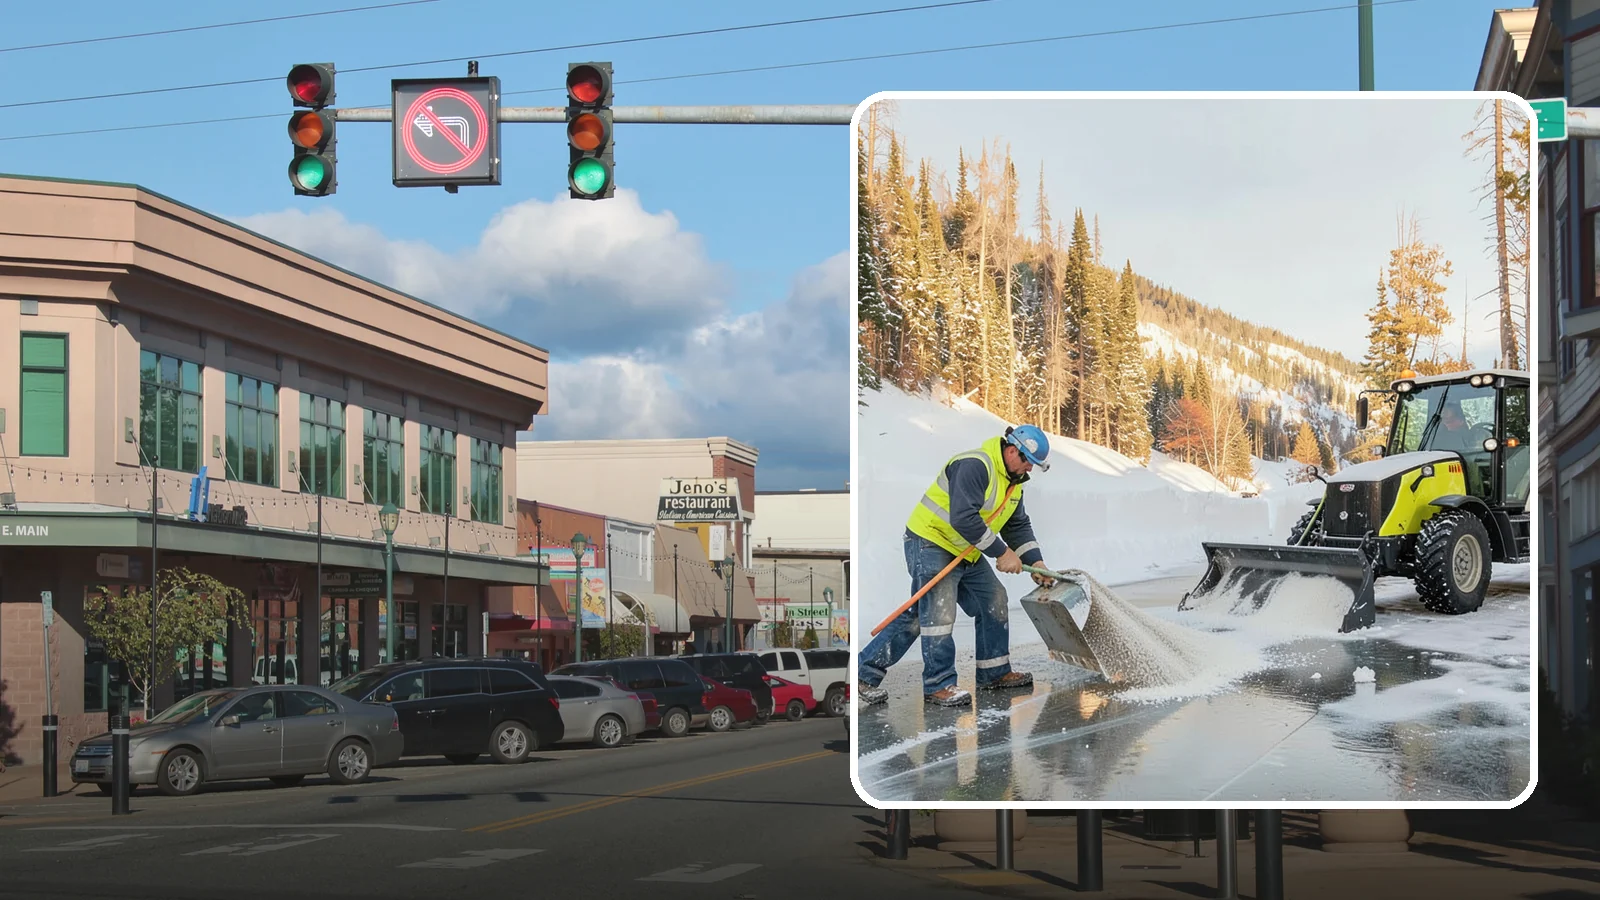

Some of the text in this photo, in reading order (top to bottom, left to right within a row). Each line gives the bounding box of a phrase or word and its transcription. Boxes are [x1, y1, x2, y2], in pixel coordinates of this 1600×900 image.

[670, 480, 728, 494] Jeno's
[665, 496, 731, 509] restaurant
[659, 510, 681, 519] Italian
[686, 509, 714, 519] American
[715, 509, 737, 519] Cuisine
[2, 525, 49, 536] E. MAIN
[797, 608, 828, 617] Street
